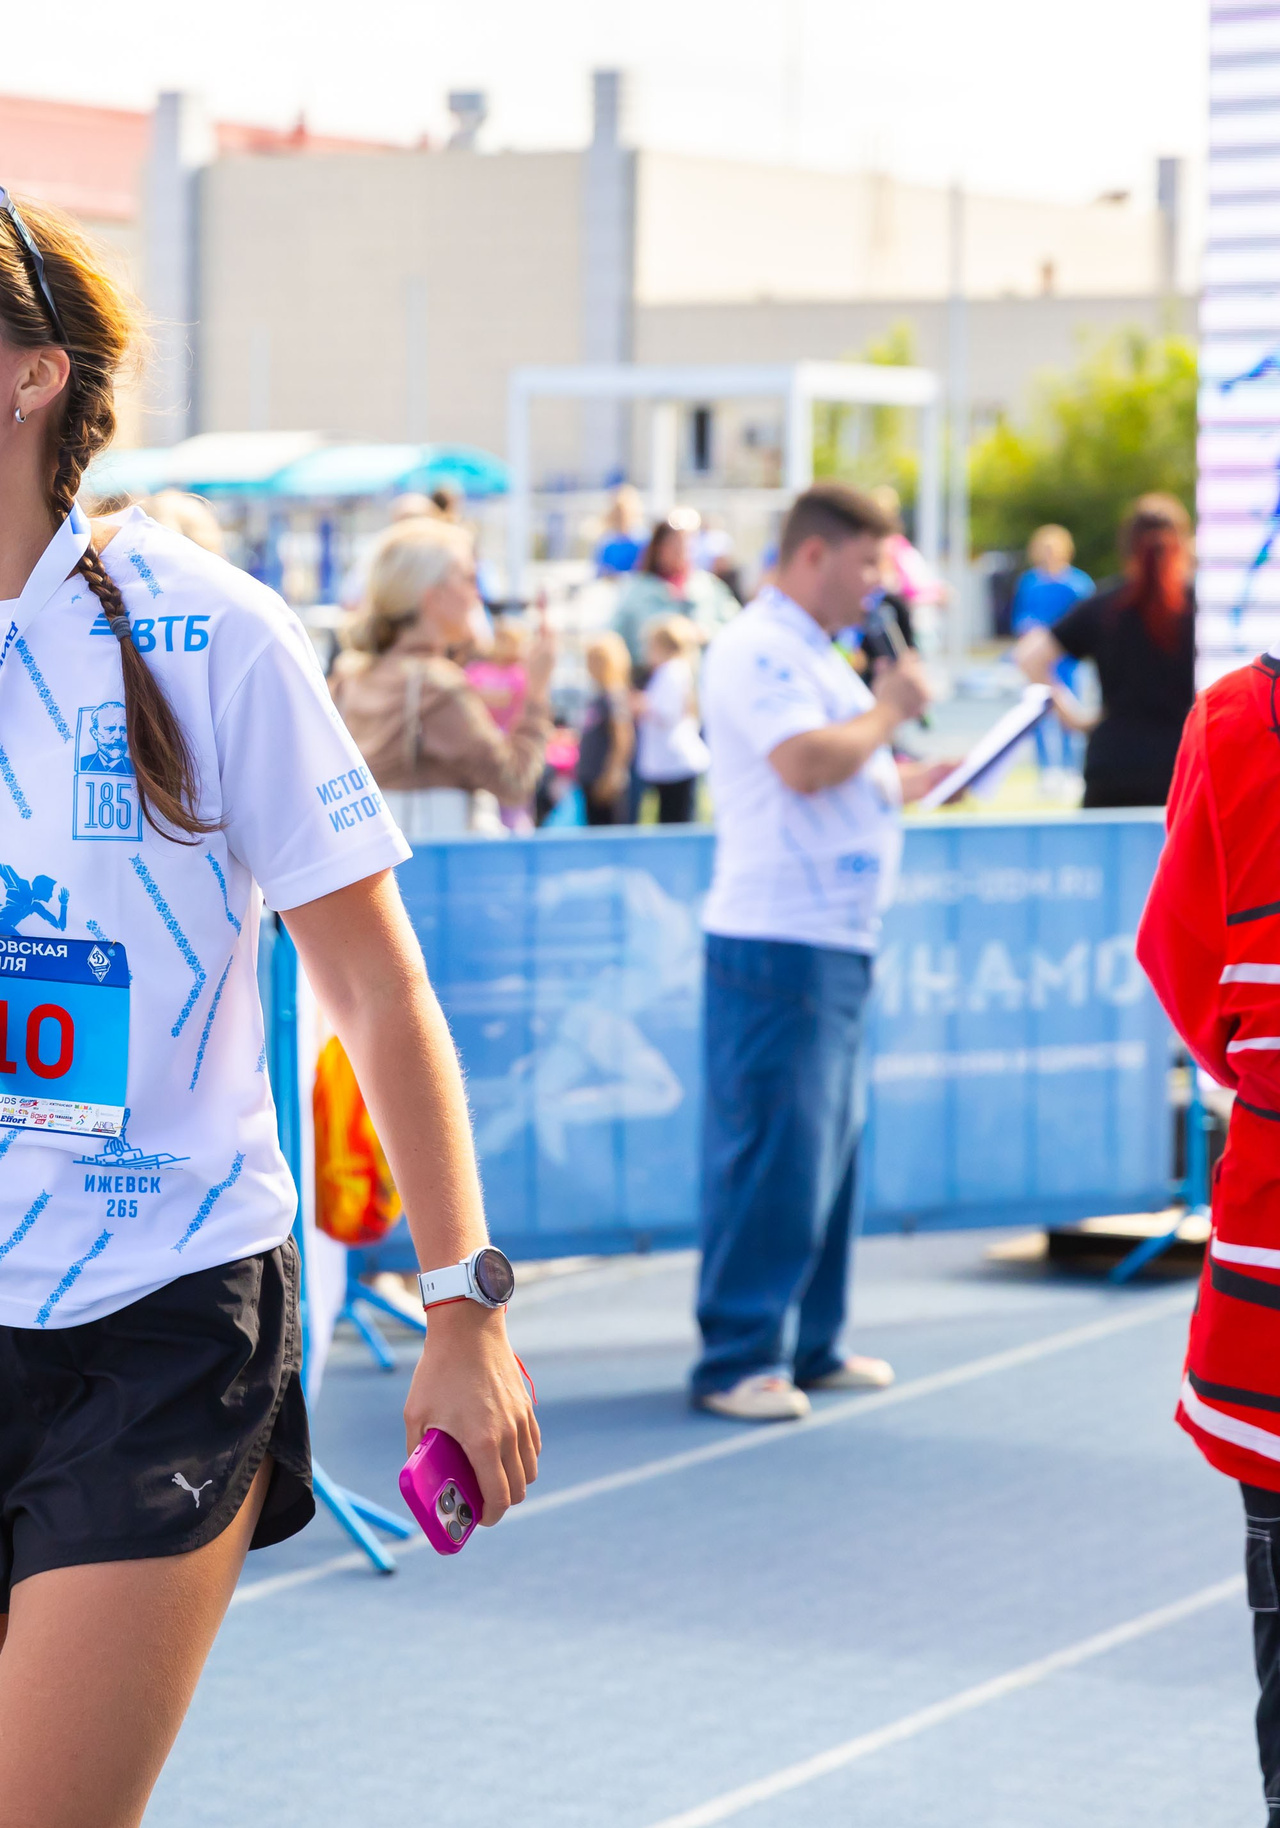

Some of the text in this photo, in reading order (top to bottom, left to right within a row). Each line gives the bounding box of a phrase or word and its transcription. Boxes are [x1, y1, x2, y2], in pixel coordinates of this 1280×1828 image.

[130, 614, 211, 653] ВТБ
[84, 782, 131, 830] 185
[0, 1115, 27, 1125] Effort
[84, 1174, 161, 1194] ИЖЕВСК
[106, 1198, 138, 1218] 265
